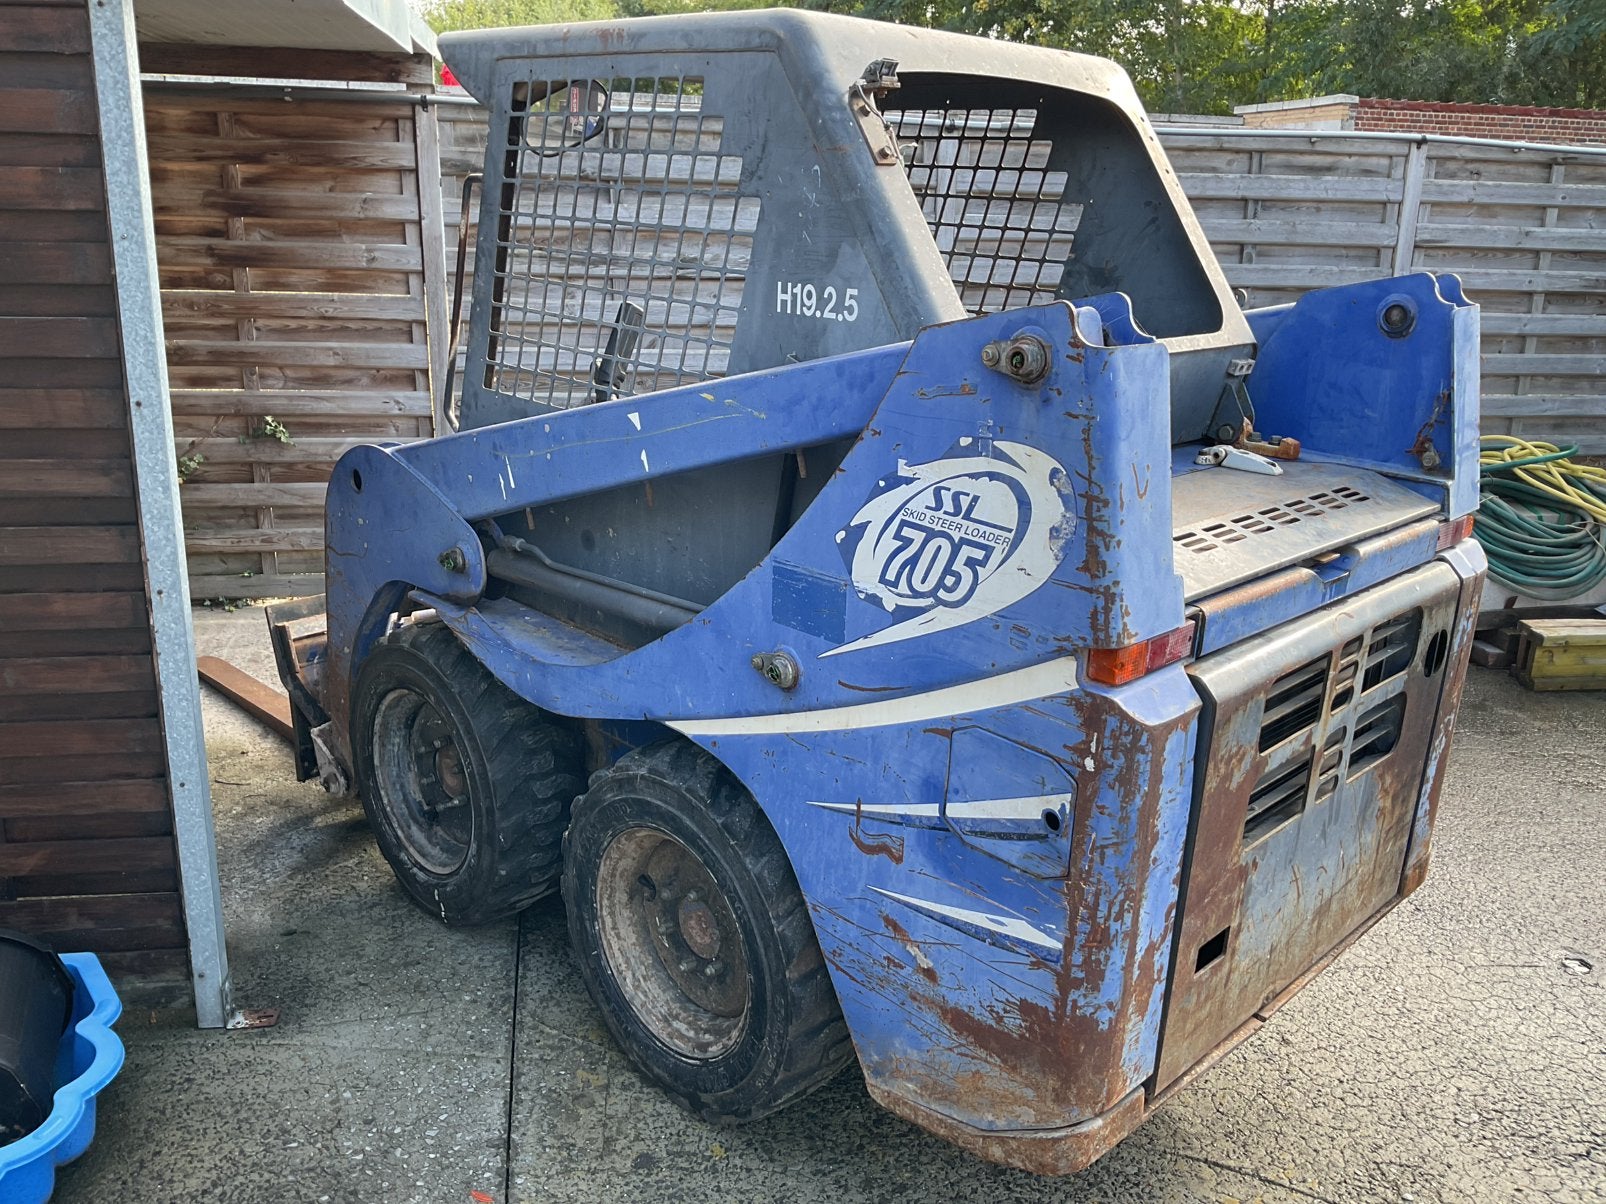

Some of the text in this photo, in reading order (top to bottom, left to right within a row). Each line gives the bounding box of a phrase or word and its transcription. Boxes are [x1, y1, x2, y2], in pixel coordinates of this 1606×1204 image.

[777, 281, 859, 321] H19.2.5
[901, 507, 1011, 548] SKID STEER LOADER
[924, 485, 1015, 534] SSL
[878, 518, 996, 609] 705
